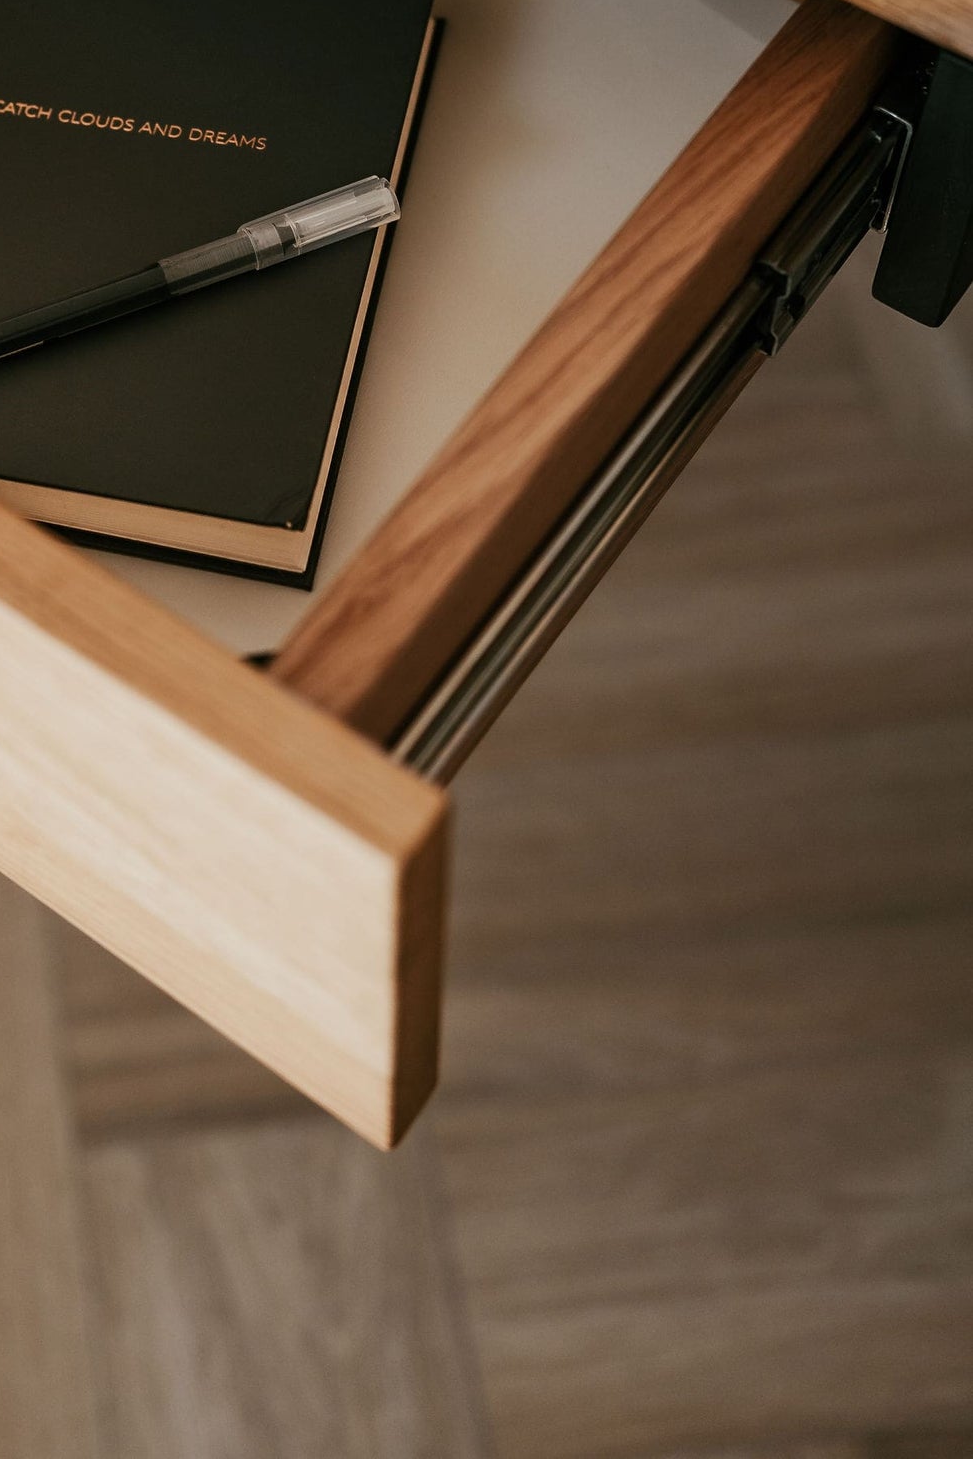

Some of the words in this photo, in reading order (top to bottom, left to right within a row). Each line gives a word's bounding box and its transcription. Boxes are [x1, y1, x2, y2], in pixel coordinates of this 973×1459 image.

[58, 109, 135, 132] CLOUDS
[138, 121, 183, 139] AND
[188, 127, 267, 150] DREAMS
